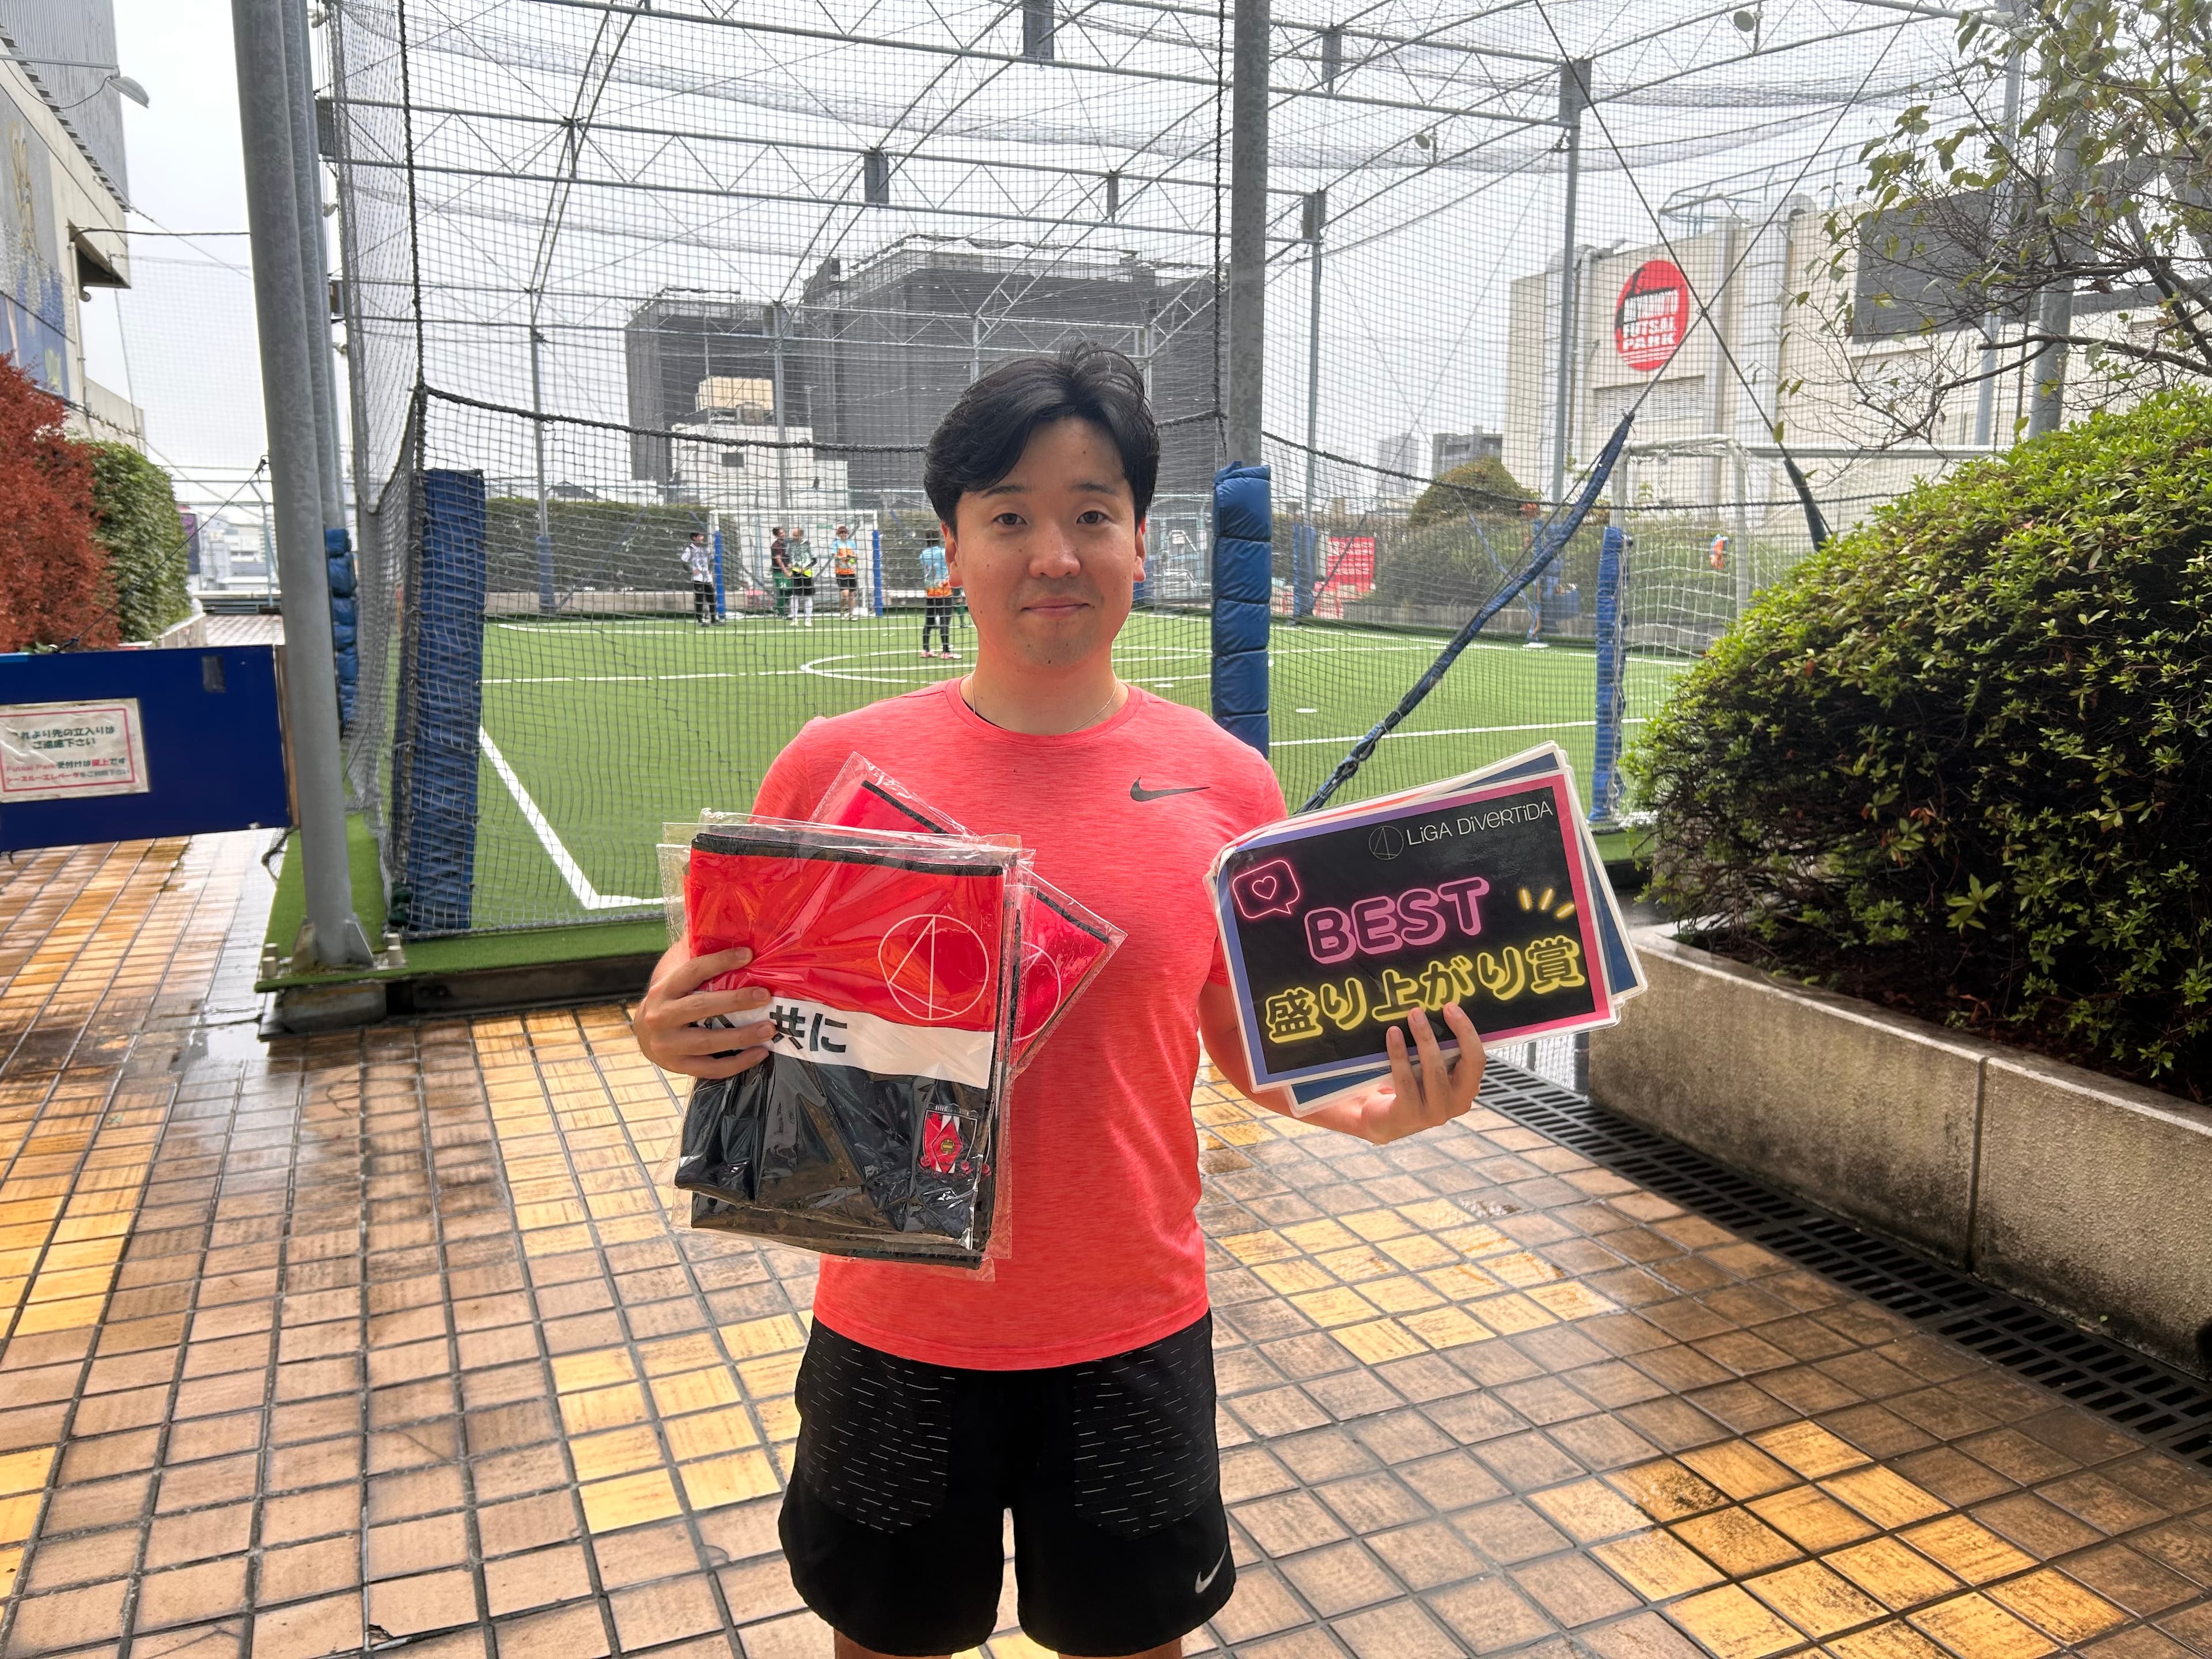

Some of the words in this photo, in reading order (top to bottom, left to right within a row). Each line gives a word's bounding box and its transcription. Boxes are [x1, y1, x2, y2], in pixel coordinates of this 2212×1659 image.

[1623, 316, 1676, 339] FUTSAL
[1623, 332, 1676, 350] PARK
[20, 726, 115, 739] れより先の立入りは
[1304, 876, 1490, 964] BEST
[1266, 935, 1586, 1044] 盛り上がり賞
